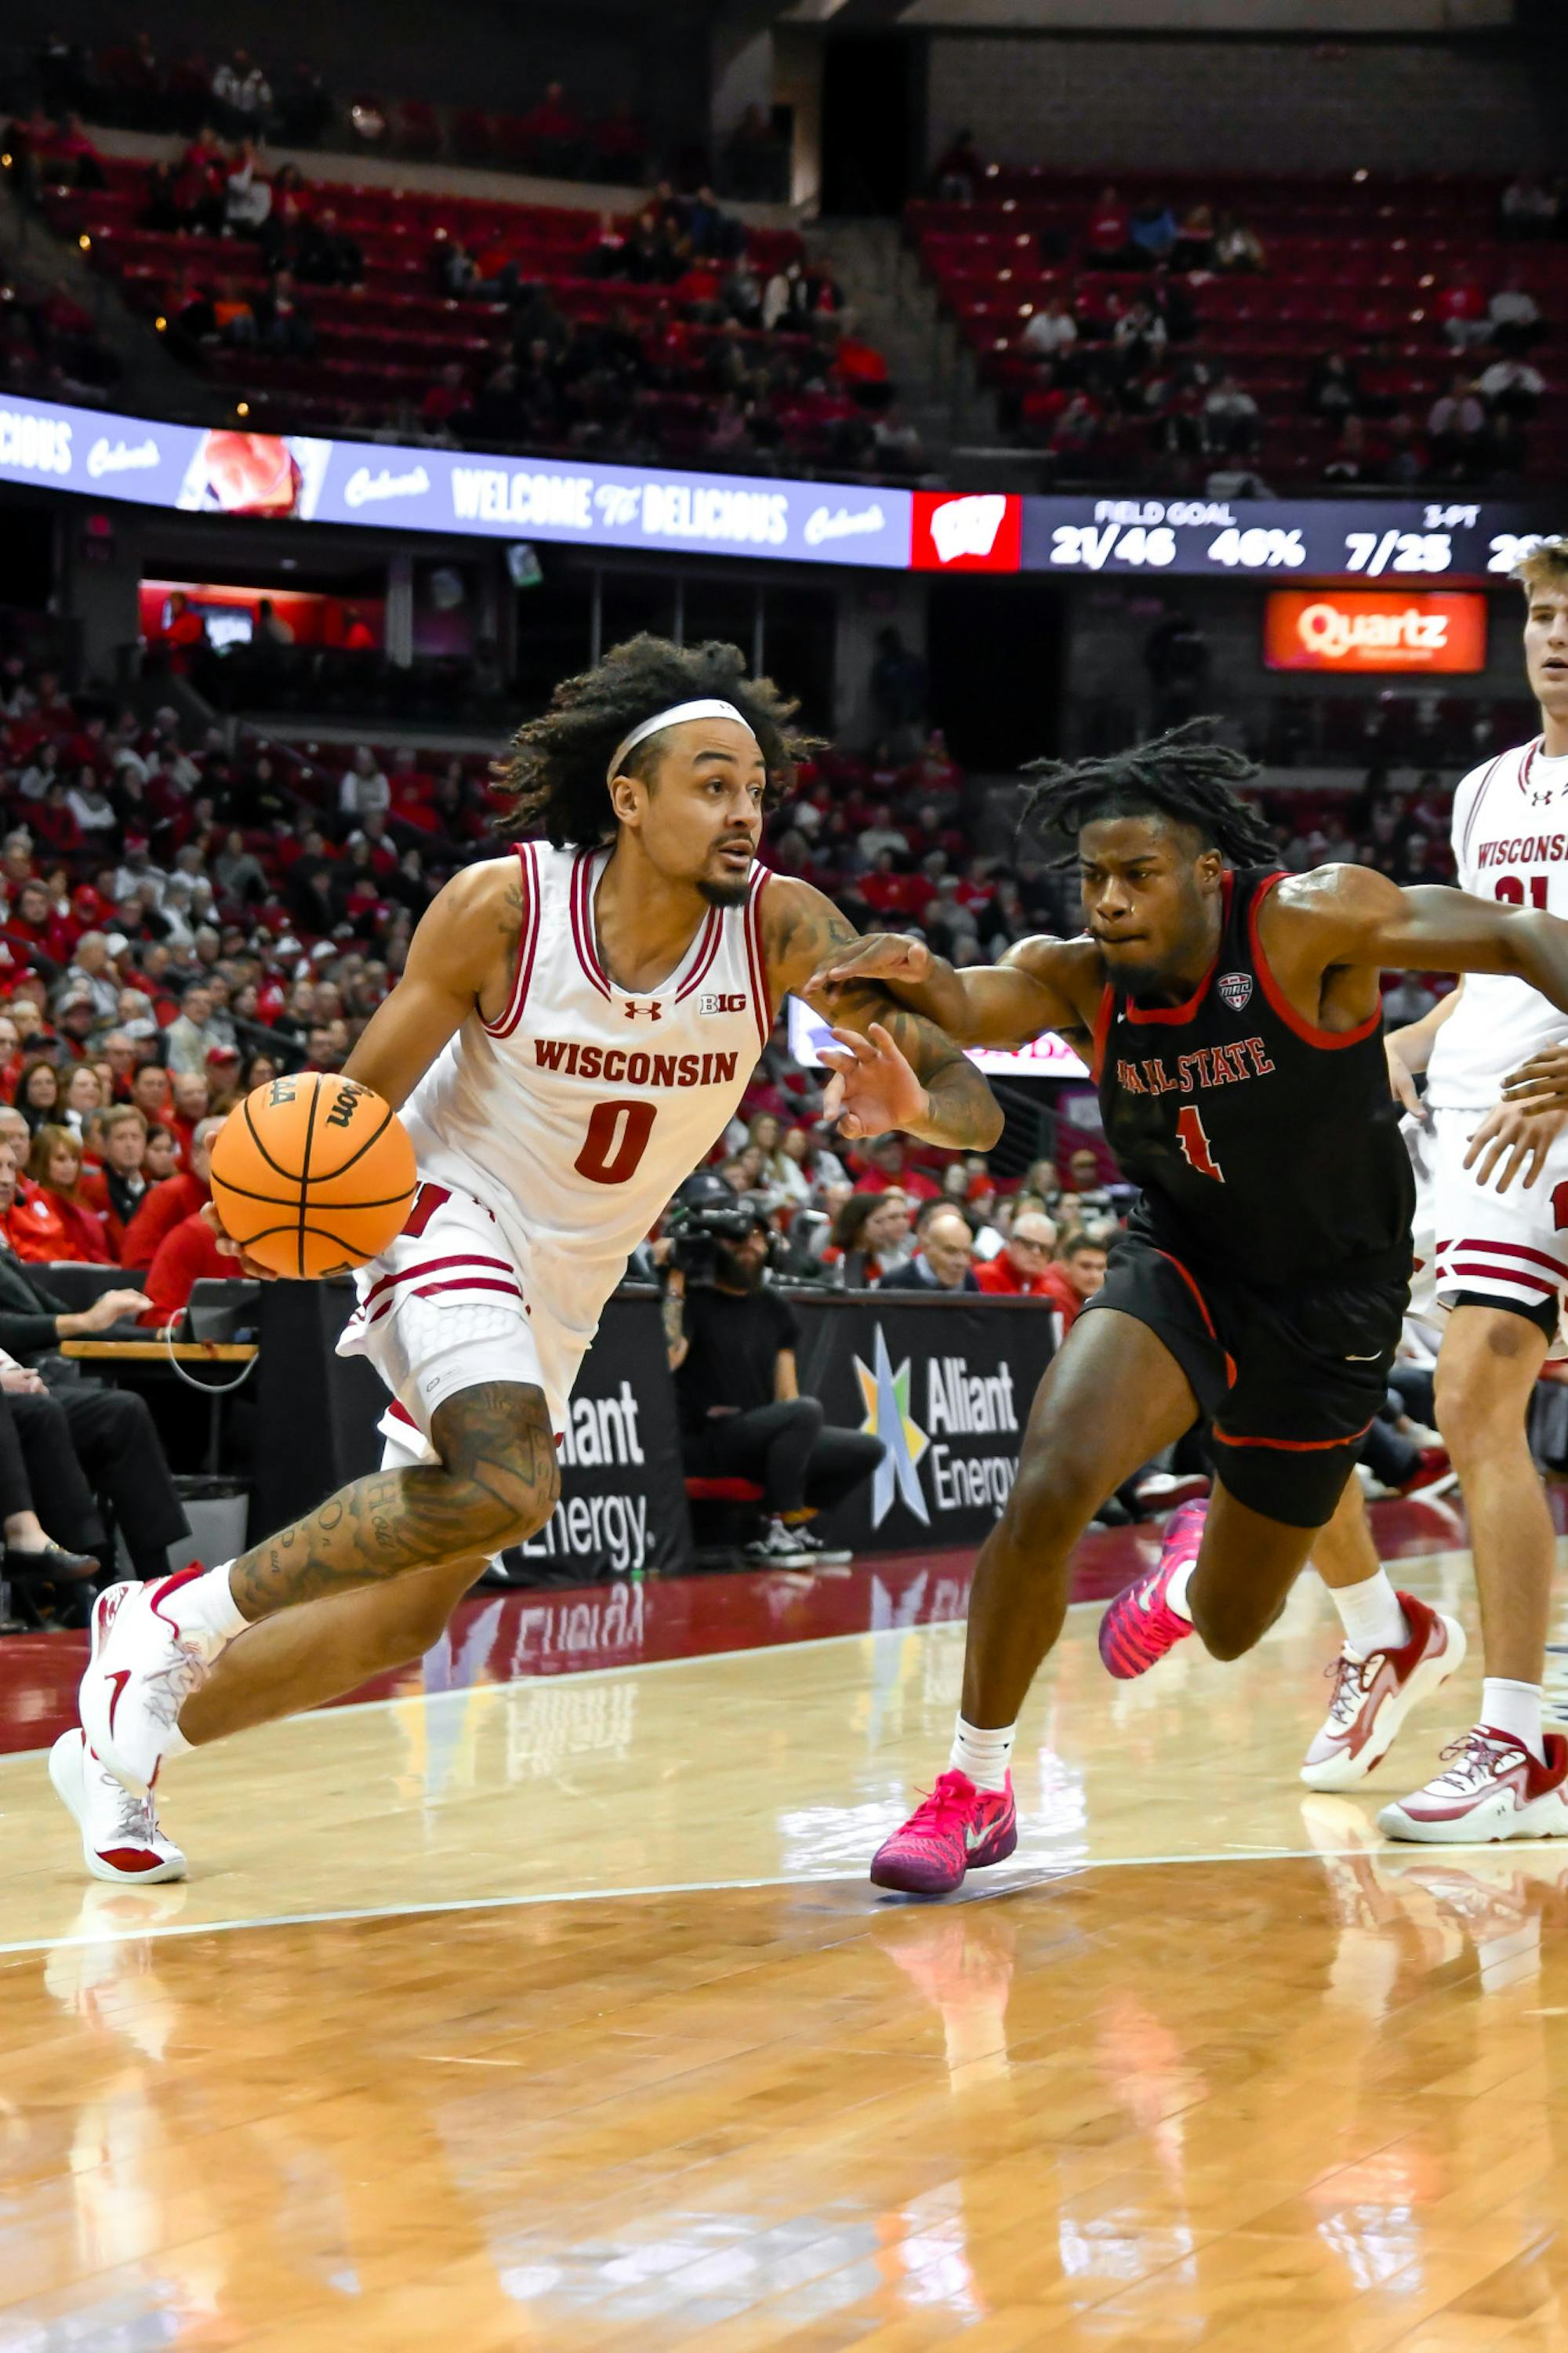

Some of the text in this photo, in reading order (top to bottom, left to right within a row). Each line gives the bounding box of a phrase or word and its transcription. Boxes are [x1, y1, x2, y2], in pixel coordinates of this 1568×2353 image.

[451, 467, 593, 529] WELCOME
[642, 484, 789, 545] DELICIOUS
[1094, 500, 1236, 526] FIELD GOAL
[1298, 604, 1449, 658] Quartz
[1478, 833, 1568, 870] WISCONS
[534, 1040, 739, 1087] WISCONSIN
[1178, 1037, 1276, 1093] STATE
[574, 1100, 657, 1185] 0
[1176, 1105, 1225, 1183] 1
[557, 1380, 645, 1466] iant
[927, 1356, 1018, 1436] Alliant
